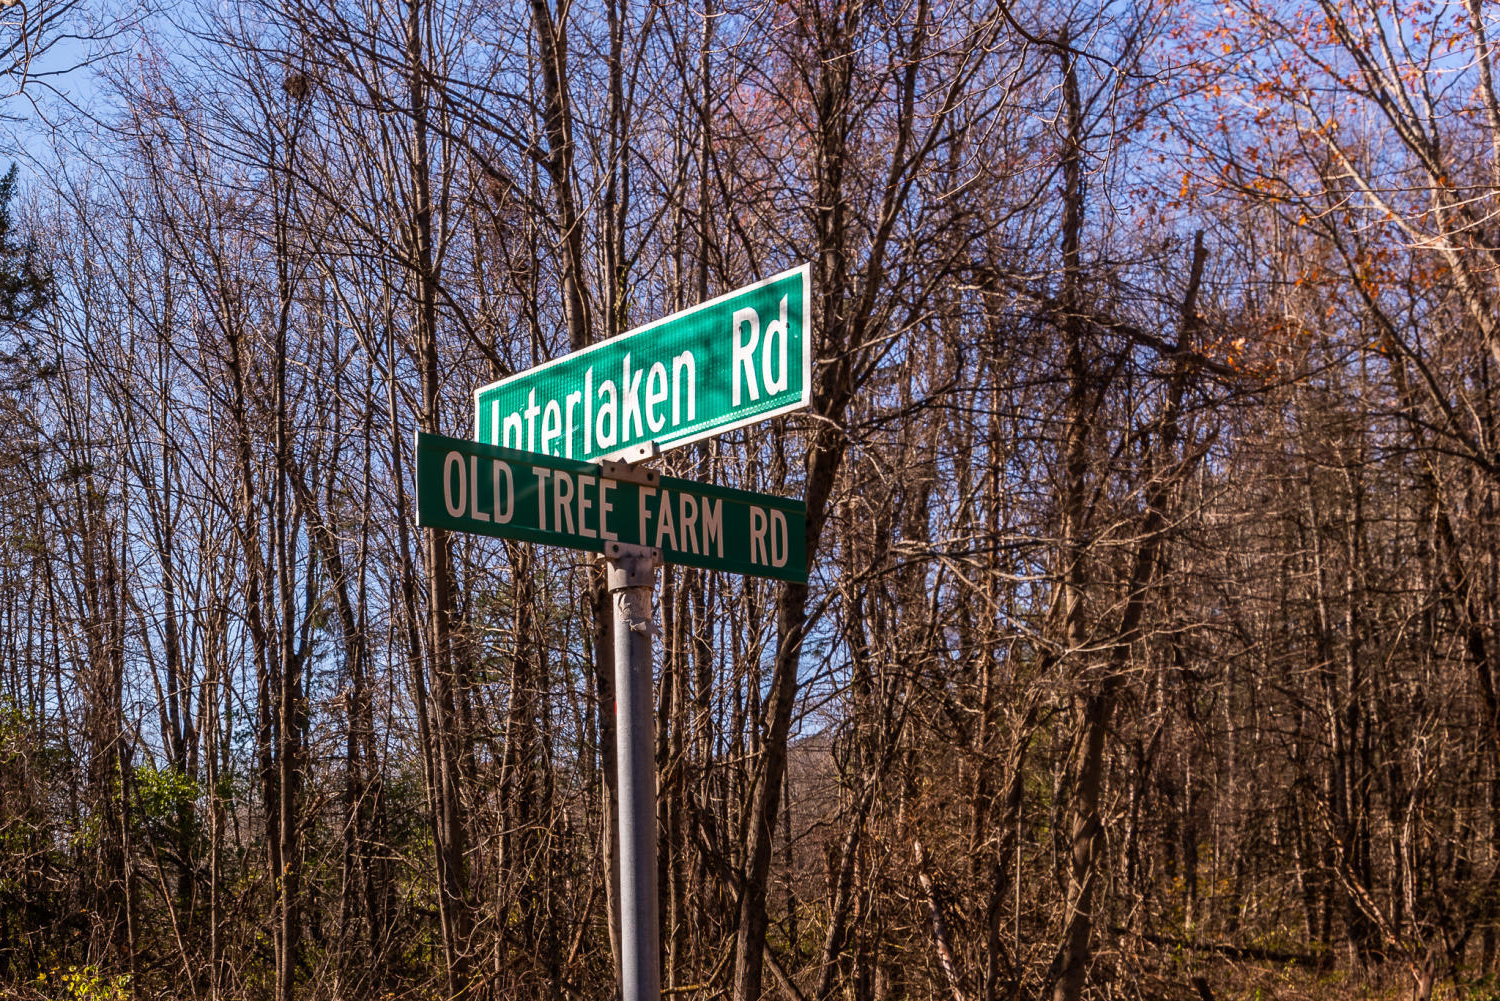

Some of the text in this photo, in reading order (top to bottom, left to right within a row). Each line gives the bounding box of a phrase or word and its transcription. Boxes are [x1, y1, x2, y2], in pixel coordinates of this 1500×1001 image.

[491, 293, 789, 459] Interlaken Rd
[442, 450, 789, 568] OLD TREE FARM RD
